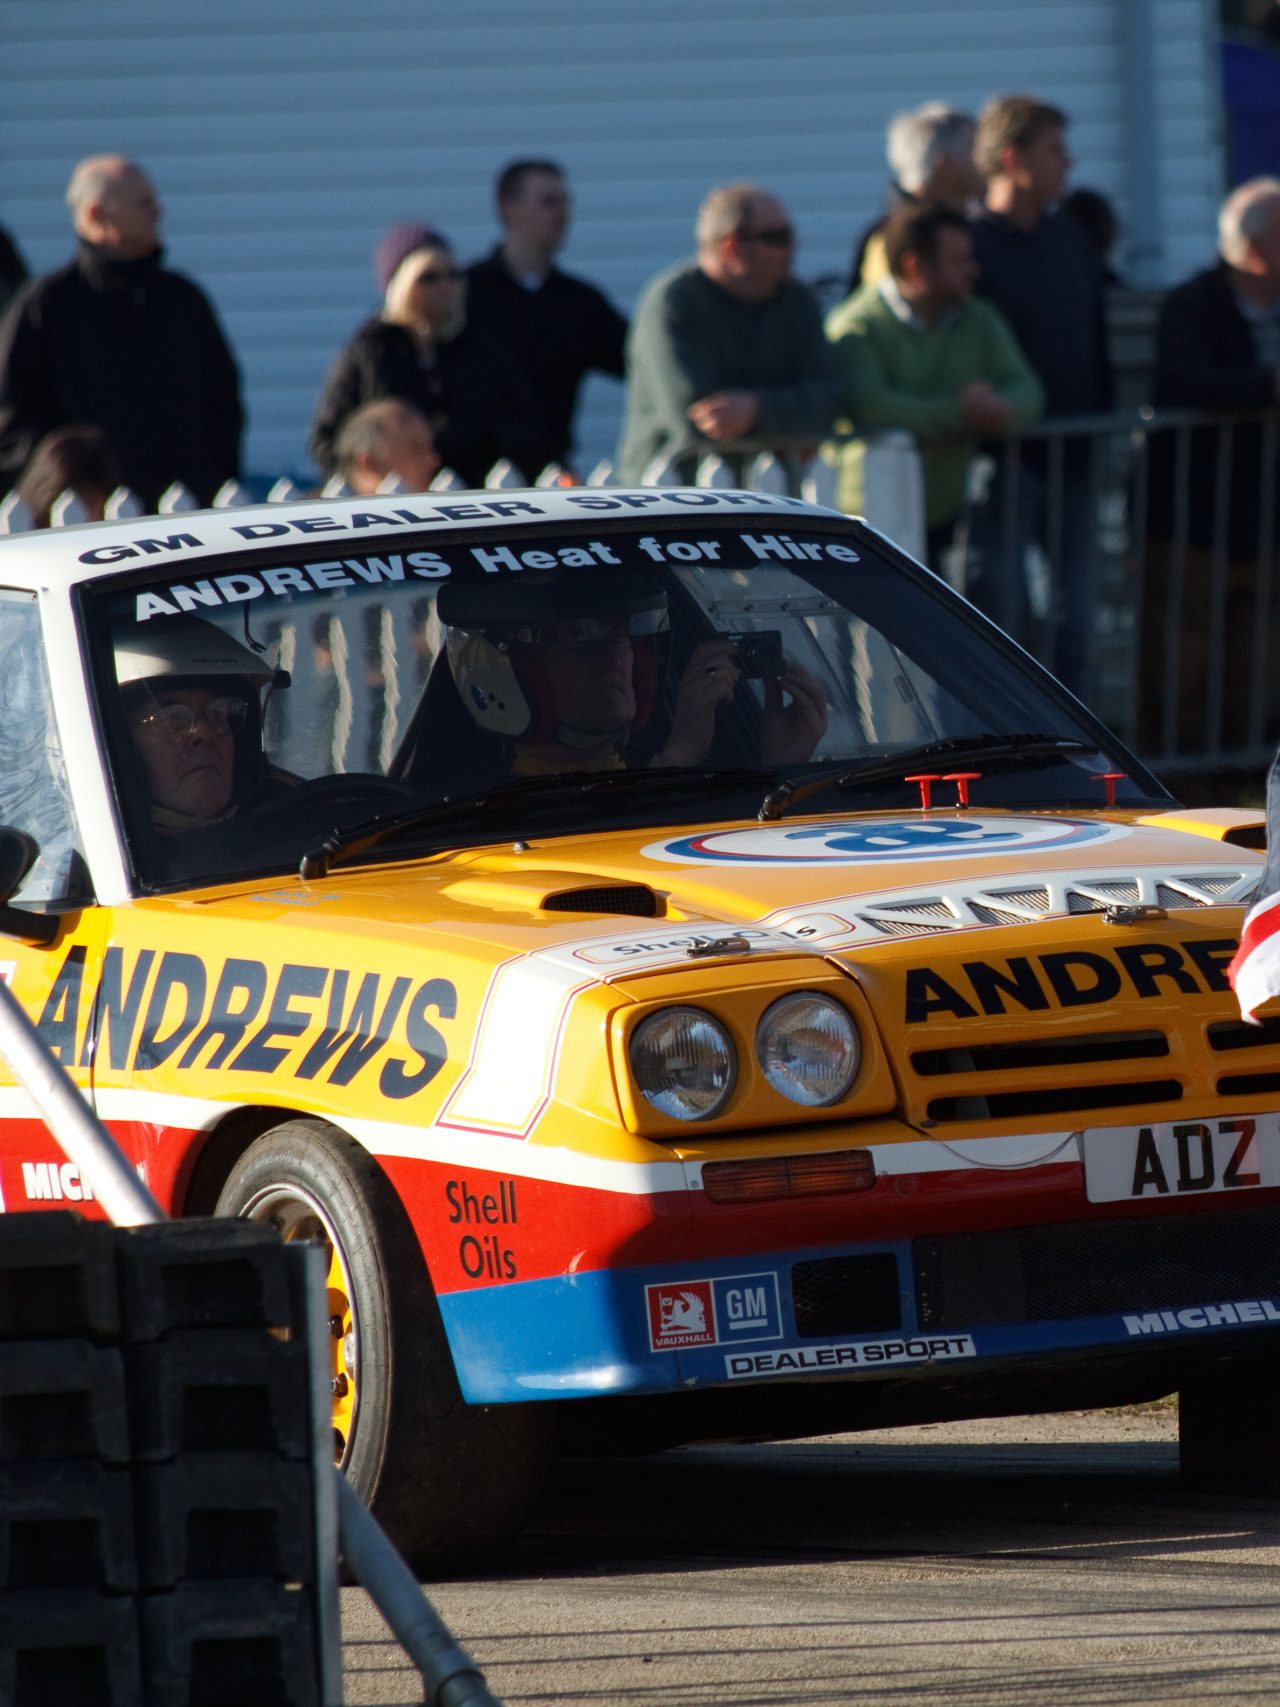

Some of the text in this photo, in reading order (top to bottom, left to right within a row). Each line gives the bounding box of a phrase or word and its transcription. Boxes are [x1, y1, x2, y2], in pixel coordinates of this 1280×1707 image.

[78, 492, 806, 565] GM DEALER SPORT
[136, 534, 861, 622] ANDREWS Heat for Hire
[905, 938, 1240, 1024] ANDRE
[35, 944, 458, 1099] ANDREWS
[1131, 1119, 1260, 1196] ADZ
[445, 1180, 517, 1224] Shell
[460, 1234, 517, 1279] Oils
[726, 1287, 767, 1320] GM
[655, 1333, 713, 1346] VAUXHALL
[730, 1337, 969, 1375] DEALER SPORT
